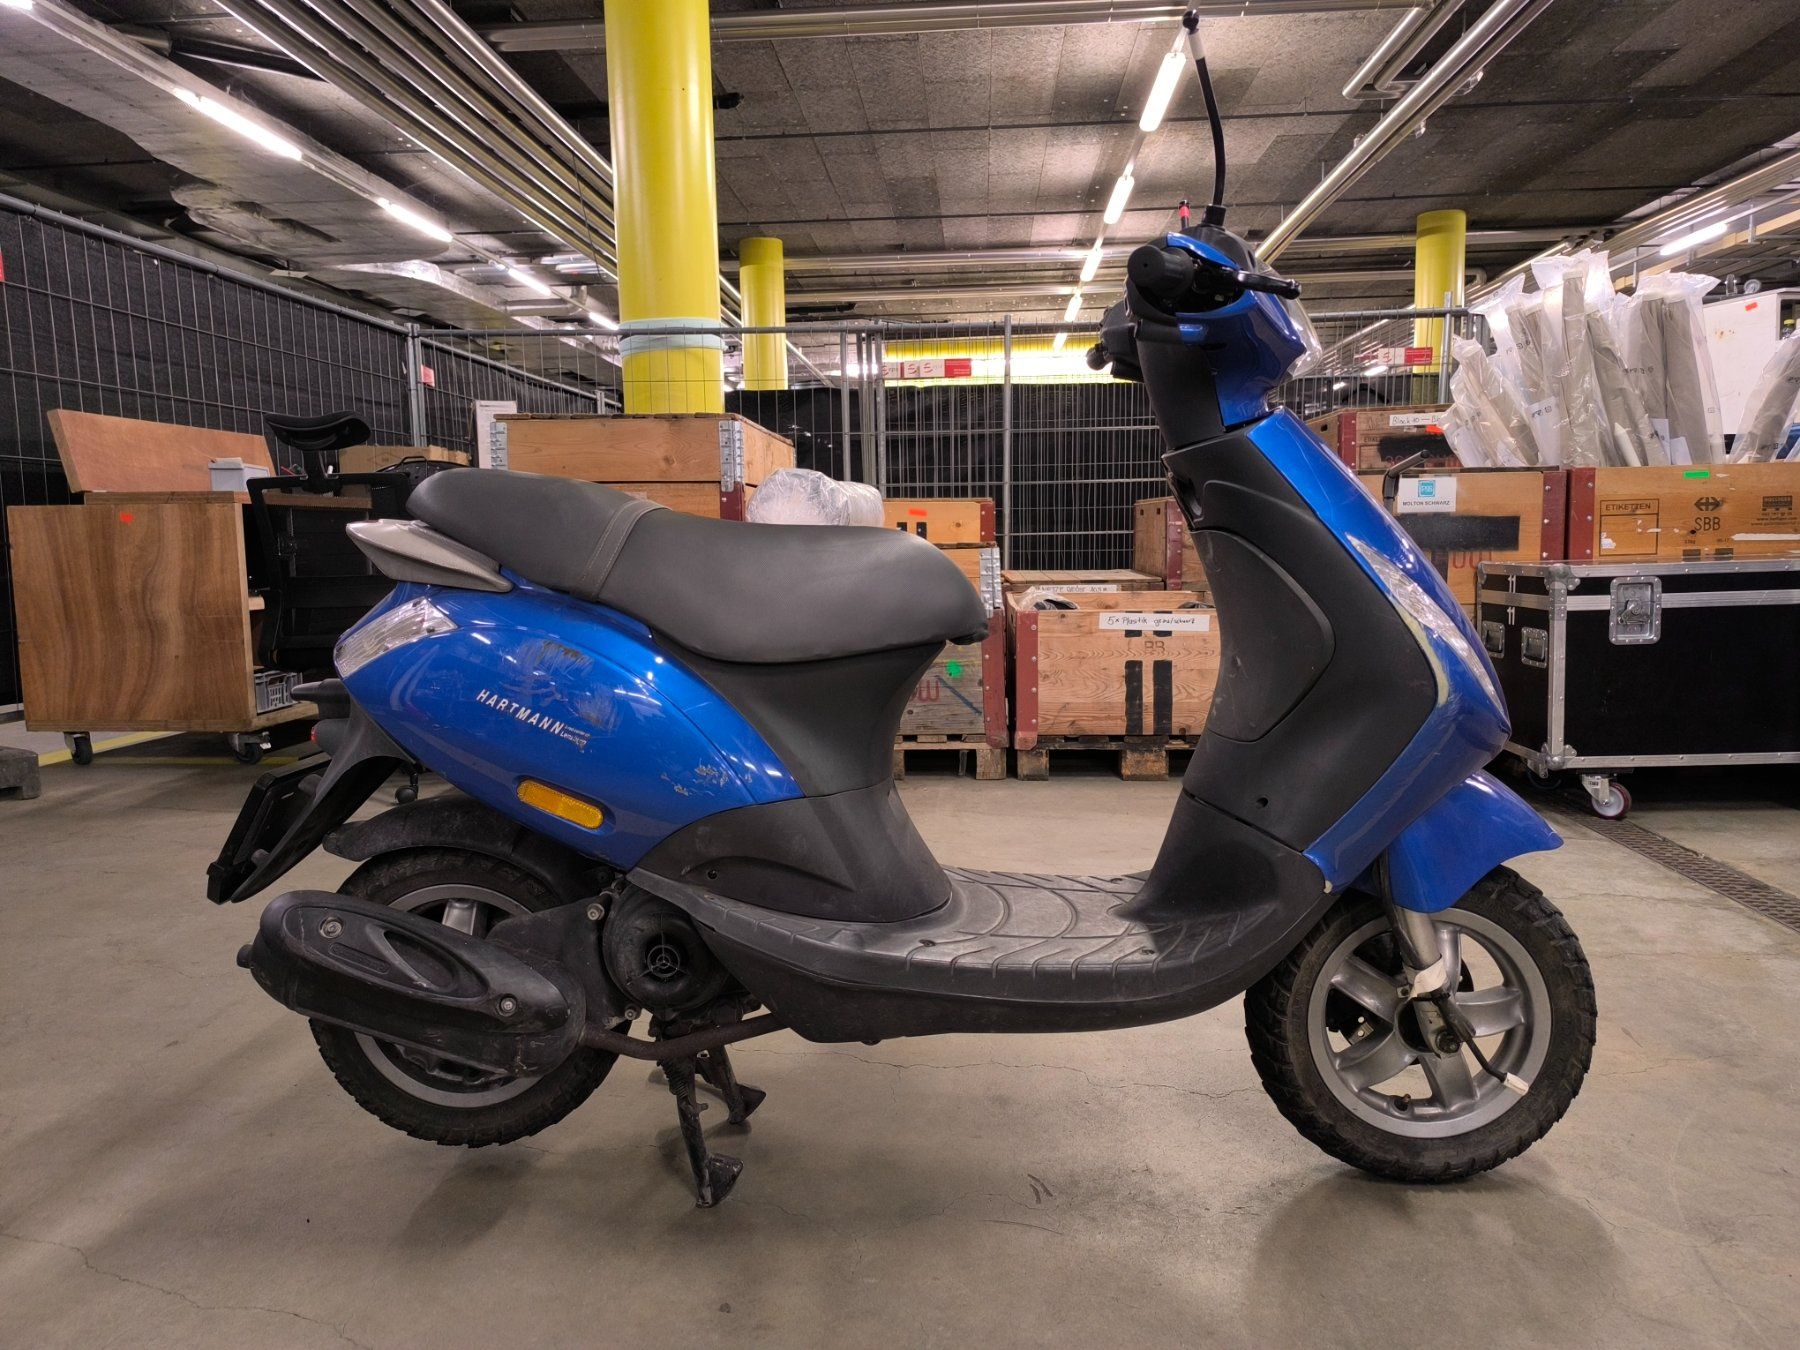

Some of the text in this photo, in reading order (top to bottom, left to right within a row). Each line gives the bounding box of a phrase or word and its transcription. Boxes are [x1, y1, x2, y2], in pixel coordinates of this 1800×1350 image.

[1605, 502, 1651, 511] ETIKETTEN
[1694, 516, 1721, 531] SBB
[1122, 617, 1148, 625] Plastik
[476, 688, 565, 735] HARTMANN
